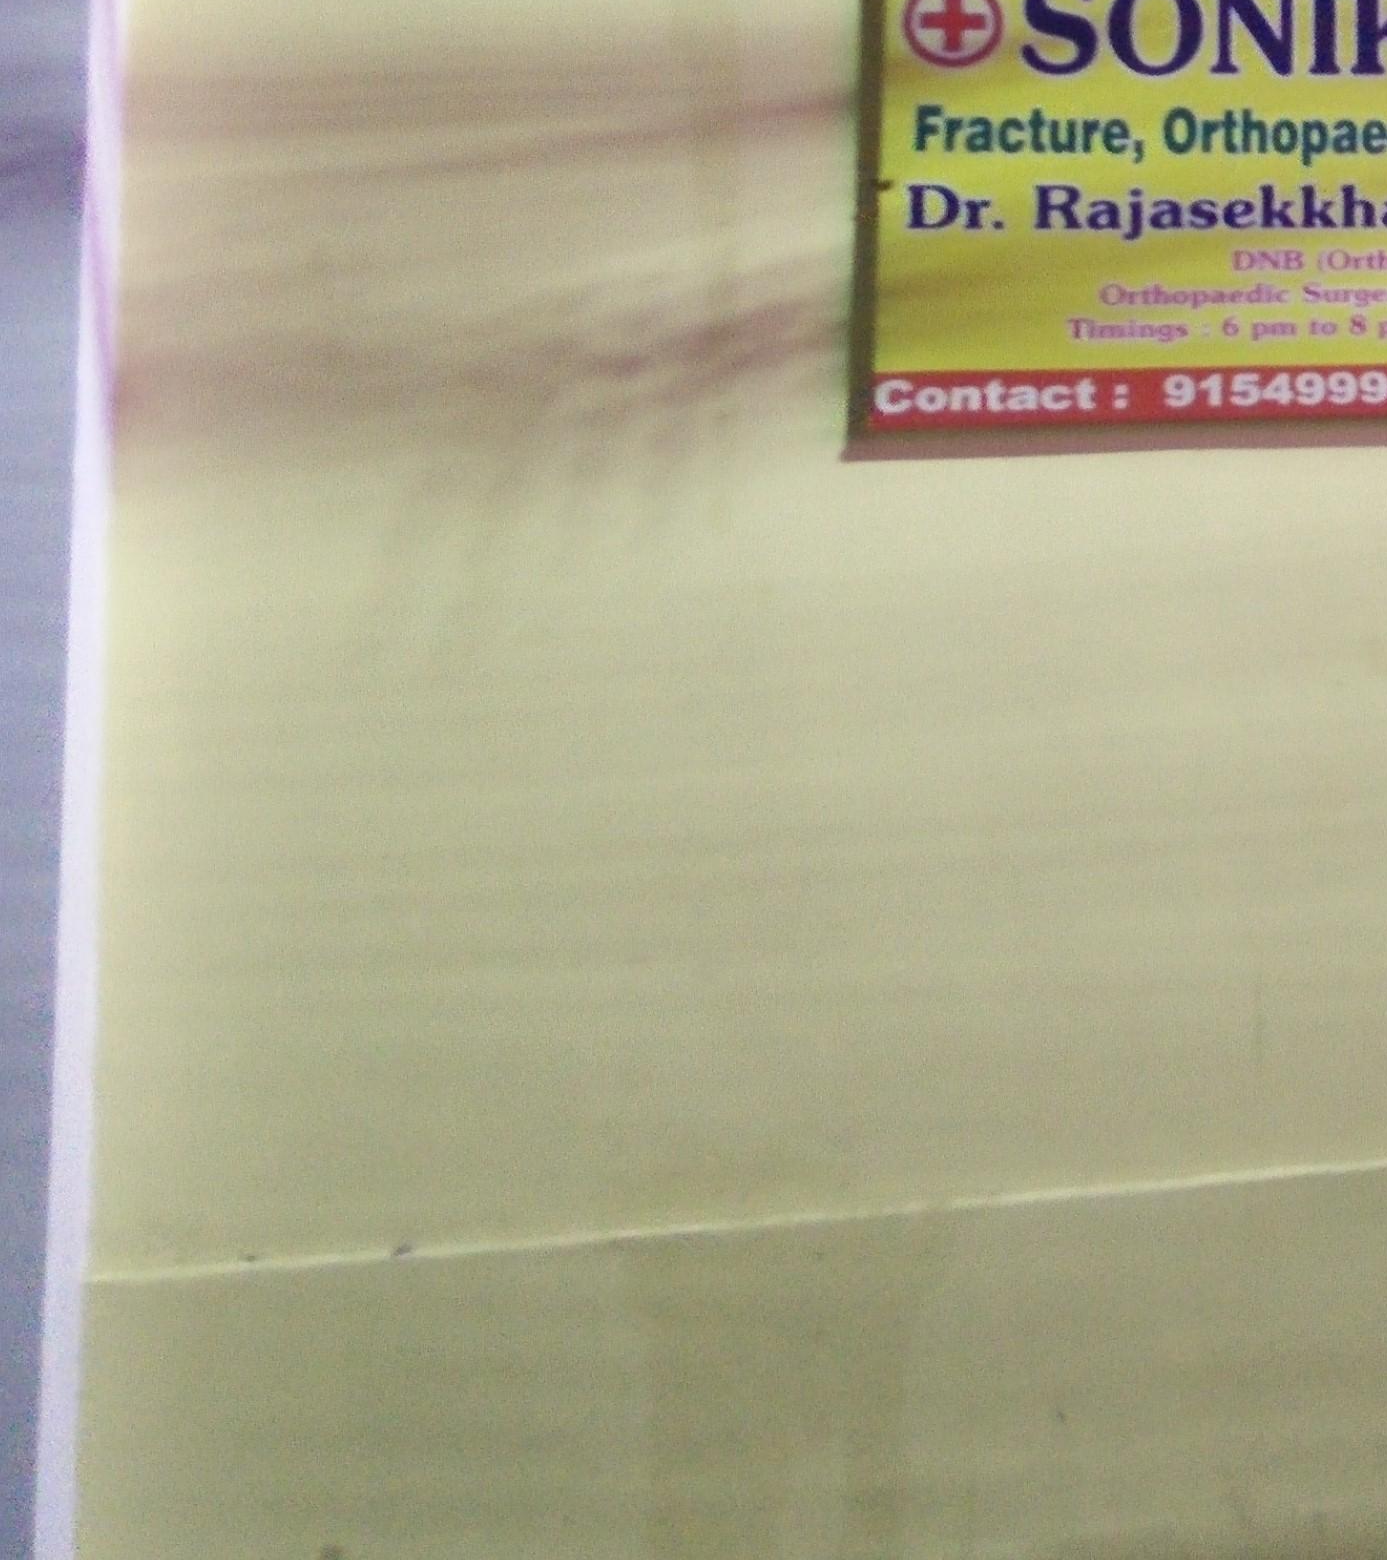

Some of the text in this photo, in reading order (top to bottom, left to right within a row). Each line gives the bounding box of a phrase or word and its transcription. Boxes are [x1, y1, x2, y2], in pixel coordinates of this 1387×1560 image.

[914, 104, 1146, 164] Fracture,
[907, 185, 1005, 231] Dr.
[1233, 249, 1304, 271] DNB
[1100, 283, 1291, 309] Orthopaedic
[1068, 317, 1189, 342] Timings
[1222, 315, 1240, 337] 6
[1251, 321, 1297, 340] pm
[1309, 320, 1338, 337] to
[874, 376, 1097, 414] Contact
